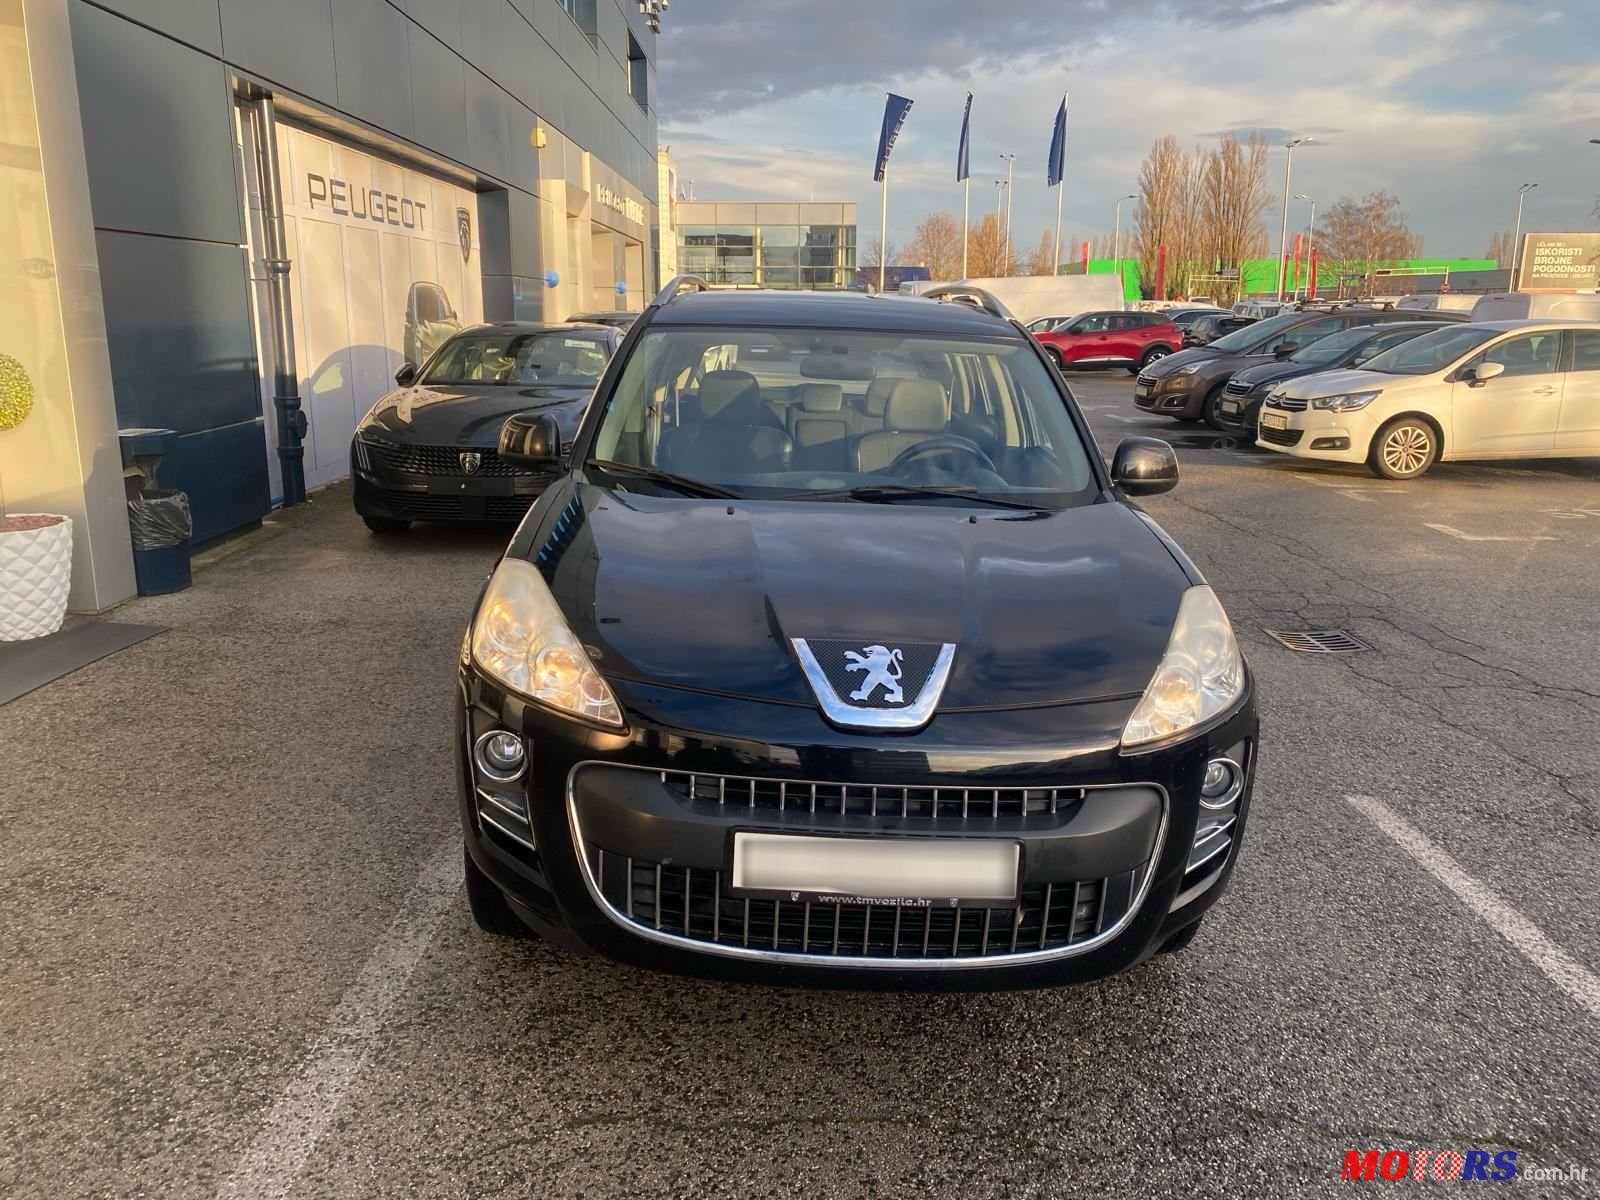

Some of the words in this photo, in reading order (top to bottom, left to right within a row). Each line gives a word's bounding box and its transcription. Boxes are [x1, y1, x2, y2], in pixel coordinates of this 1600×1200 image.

[307, 172, 426, 231] PEUGEOT
[1535, 247, 1583, 256] ISKORISTI
[1534, 256, 1573, 264] BROJNE
[1533, 264, 1596, 273] POGODNOSTI
[818, 894, 932, 907] www.tmvozila.hr
